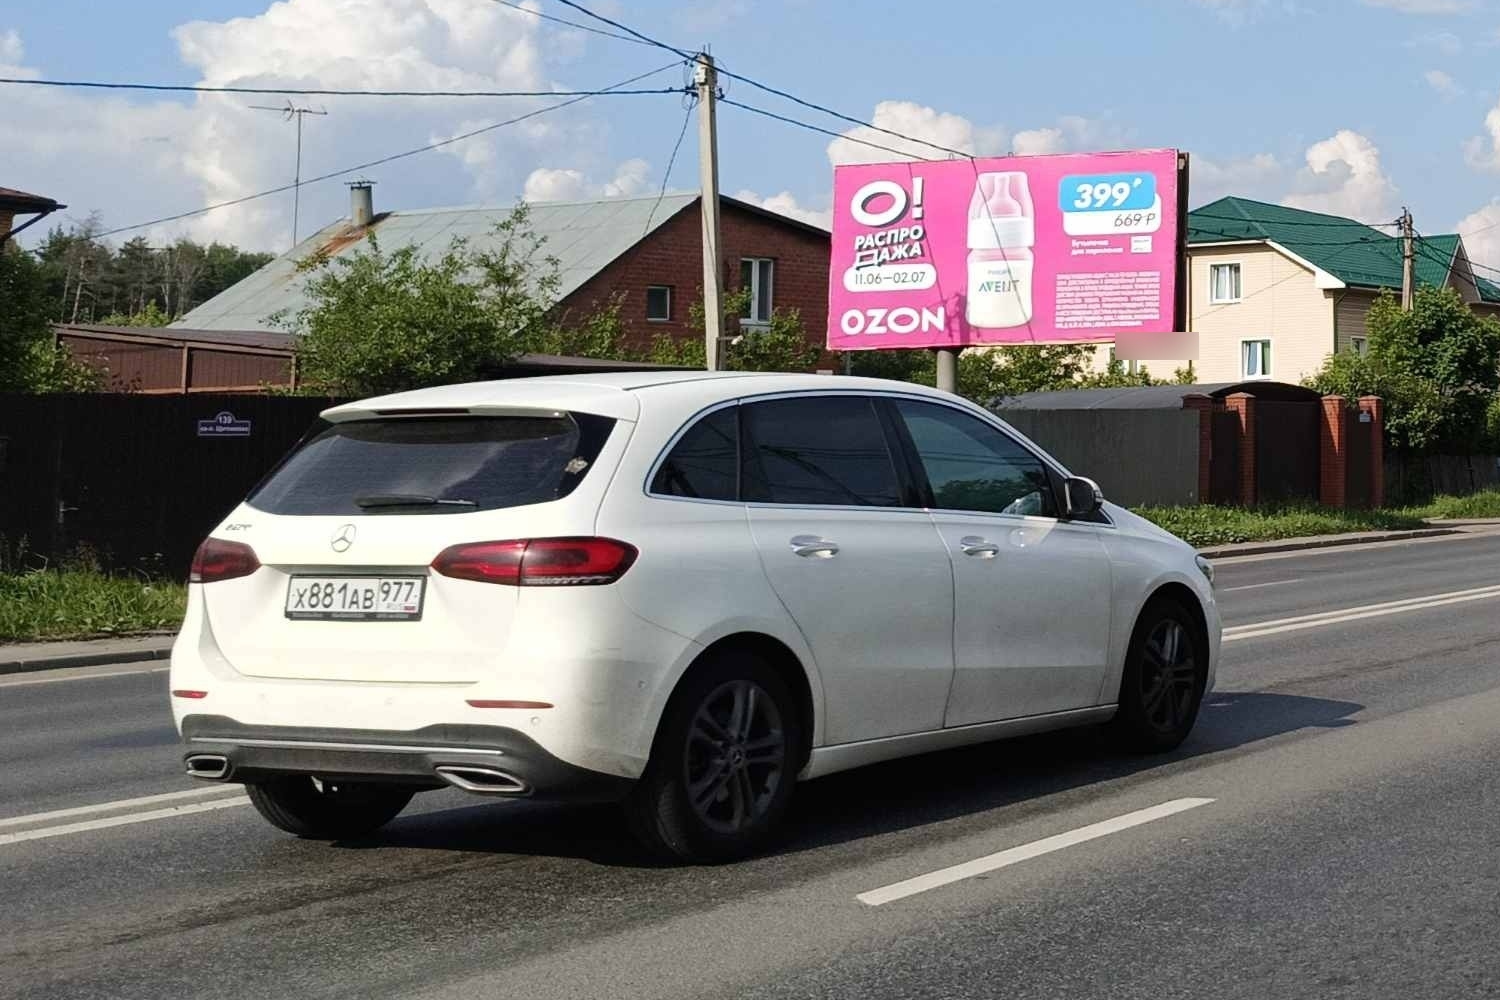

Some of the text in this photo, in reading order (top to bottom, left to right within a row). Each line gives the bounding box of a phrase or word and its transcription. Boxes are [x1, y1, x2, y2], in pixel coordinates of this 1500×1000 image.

[851, 177, 924, 228] О!
[855, 225, 926, 250] РАСПРО
[855, 241, 924, 270] ДАЖА
[979, 279, 1020, 292] AVENT
[841, 305, 945, 335] OZON
[294, 581, 415, 609] Х881АВ 977
